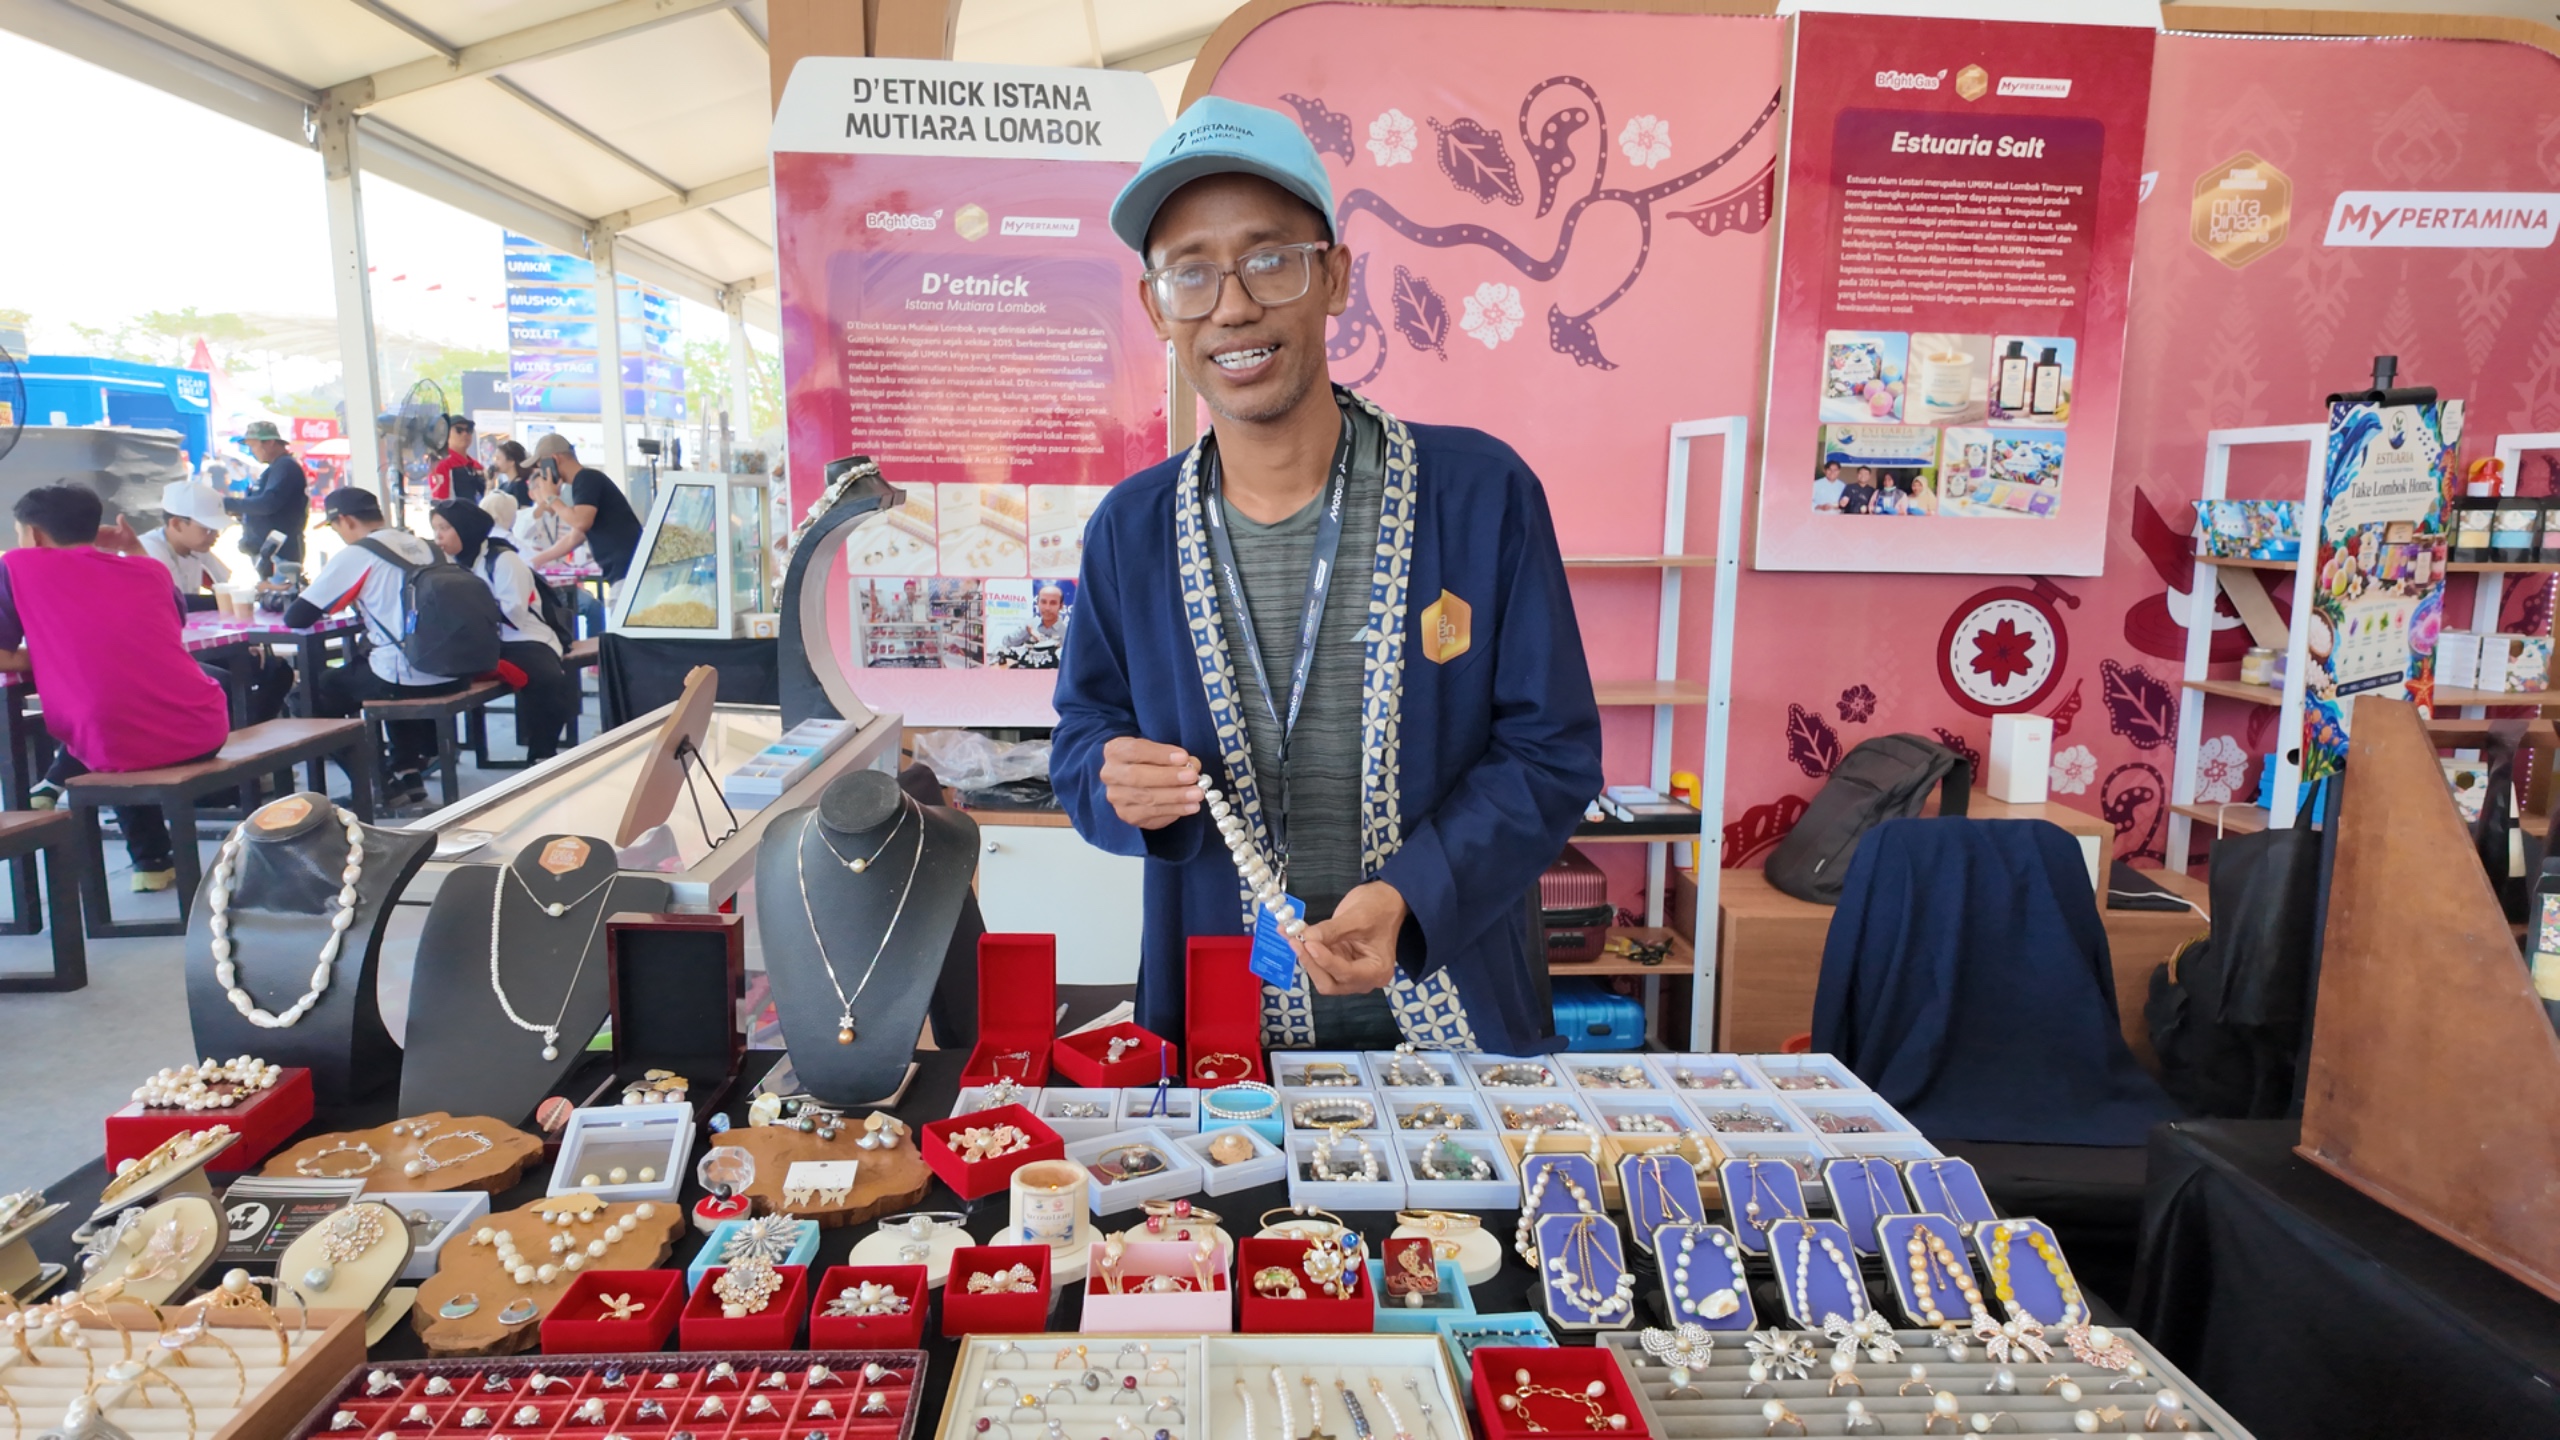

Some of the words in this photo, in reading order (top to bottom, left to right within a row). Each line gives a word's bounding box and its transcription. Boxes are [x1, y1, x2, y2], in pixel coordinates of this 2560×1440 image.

[1878, 72, 1914, 90] Bright
[1915, 75, 1938, 88] Gas
[853, 78, 985, 107] D'ETNICK
[994, 82, 1092, 111] ISTANA
[845, 113, 976, 141] MUTIARA
[985, 117, 1102, 146] LOMBOK
[1189, 124, 1254, 138] PERTAMINA
[1891, 131, 1993, 156] Estuaria
[1996, 135, 2046, 159] Salt
[2211, 195, 2261, 217] mitra
[868, 213, 909, 232] Bright
[909, 215, 936, 229] Gas
[2211, 212, 2271, 231] binaan
[507, 262, 551, 273] UMKM
[921, 272, 1030, 297] D'etnick
[510, 295, 576, 307] MUSHOLA
[905, 299, 944, 311] Istana
[947, 300, 995, 313] Mutiara
[997, 301, 1047, 314] Lombok
[511, 329, 560, 340] TOILET
[513, 362, 551, 373] MINI
[553, 362, 594, 374] STAGE
[515, 394, 542, 406] VIP
[2376, 451, 2414, 465] ESTUARIA
[2351, 481, 2371, 499] Take
[2373, 479, 2408, 498] Lombok
